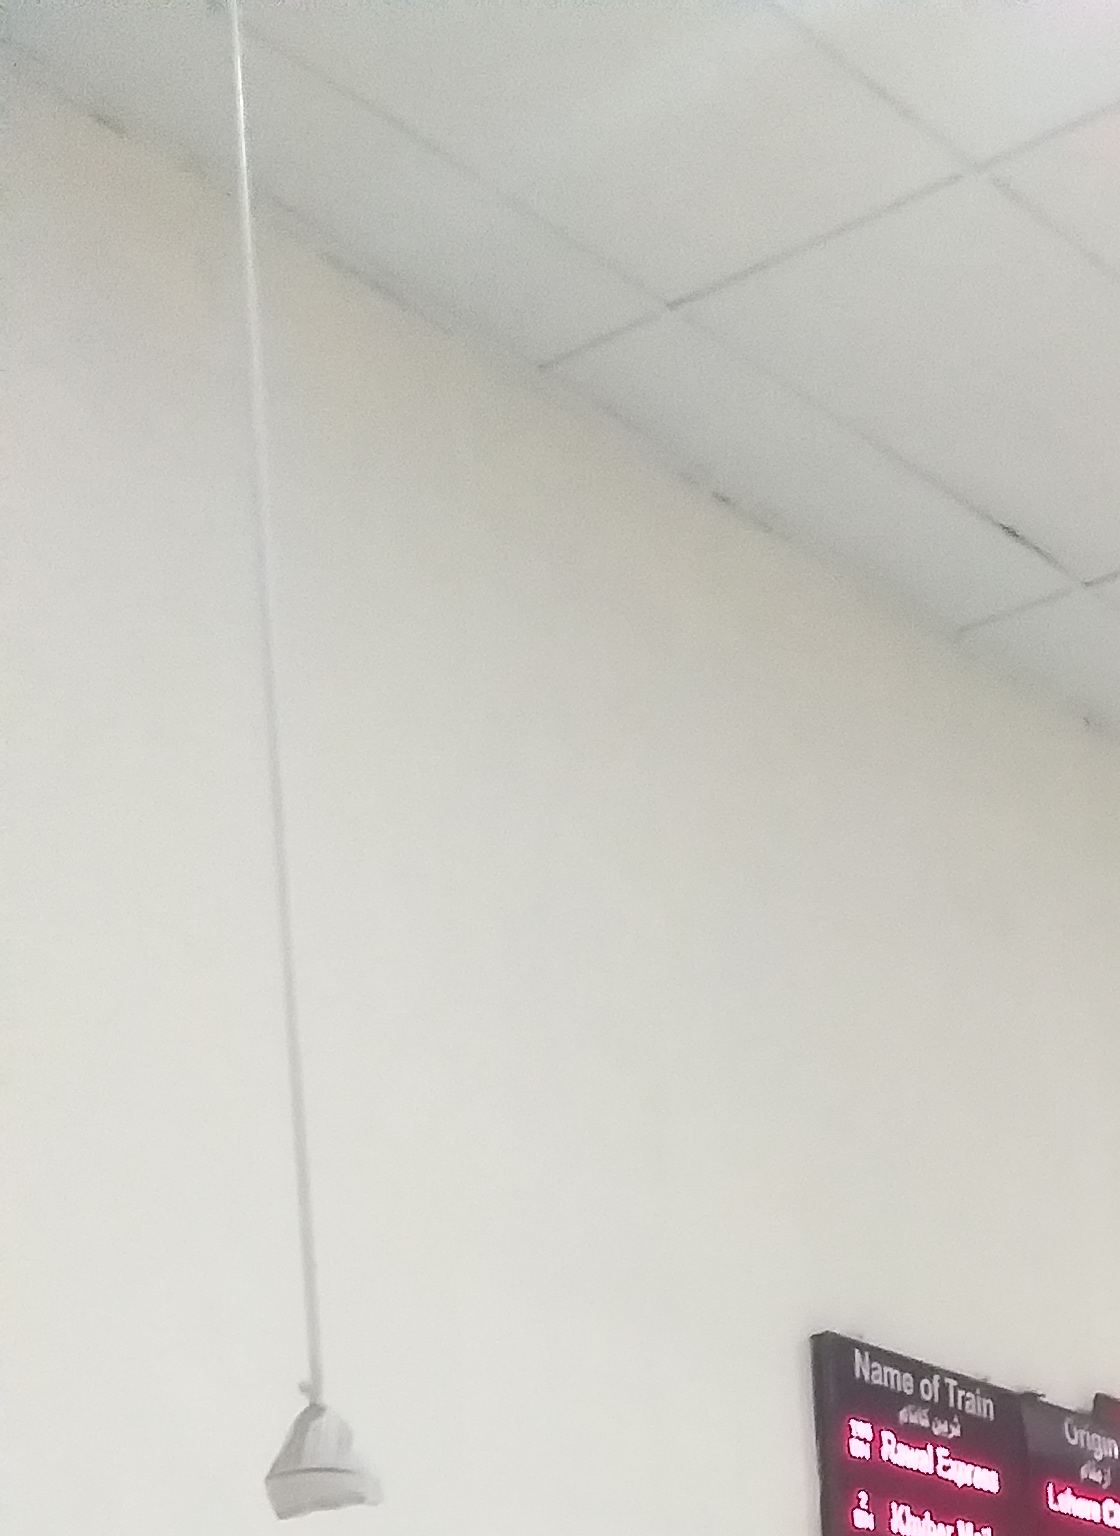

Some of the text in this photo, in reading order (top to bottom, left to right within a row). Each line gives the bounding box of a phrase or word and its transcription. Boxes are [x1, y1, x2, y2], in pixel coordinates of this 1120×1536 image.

[855, 1348, 995, 1421] Name of Train
[1064, 1417, 1119, 1461] Origin
